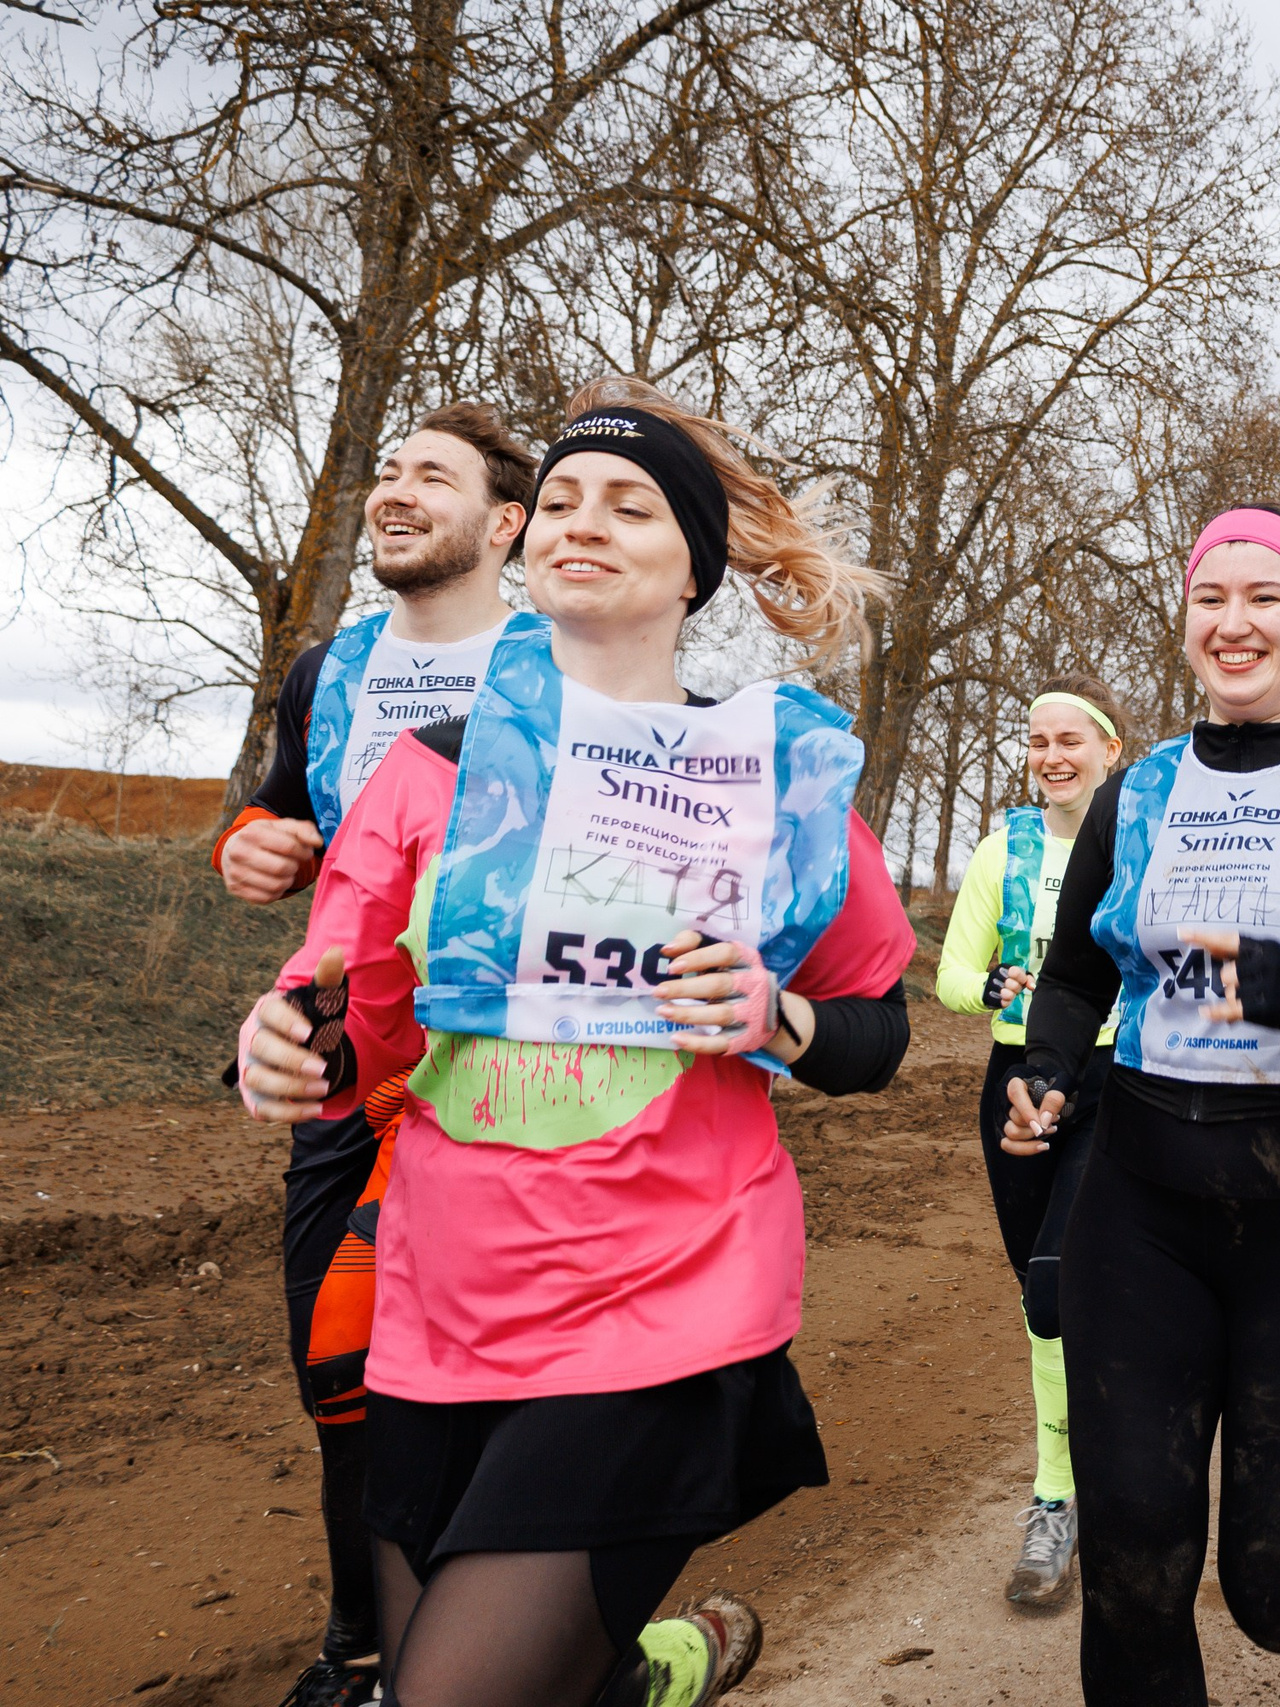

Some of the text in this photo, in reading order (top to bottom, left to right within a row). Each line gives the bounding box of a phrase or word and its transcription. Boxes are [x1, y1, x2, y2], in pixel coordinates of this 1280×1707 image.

[368, 675, 476, 690] ГОНКА ГЕРОЕВ
[376, 700, 453, 720] Sminex
[571, 742, 660, 769] ГОНКА
[598, 768, 734, 828] Sminex
[1169, 810, 1227, 824] ГОНКА
[586, 831, 620, 846] FINE
[1177, 832, 1276, 853] Sminex
[1171, 863, 1271, 873] ПЕРФЕКЦИОНИСТЫ
[561, 843, 746, 931] КАТЯ
[1194, 875, 1268, 884] DEVELOPMENT
[1183, 1037, 1258, 1050] ГАЗПРОМБАНК
